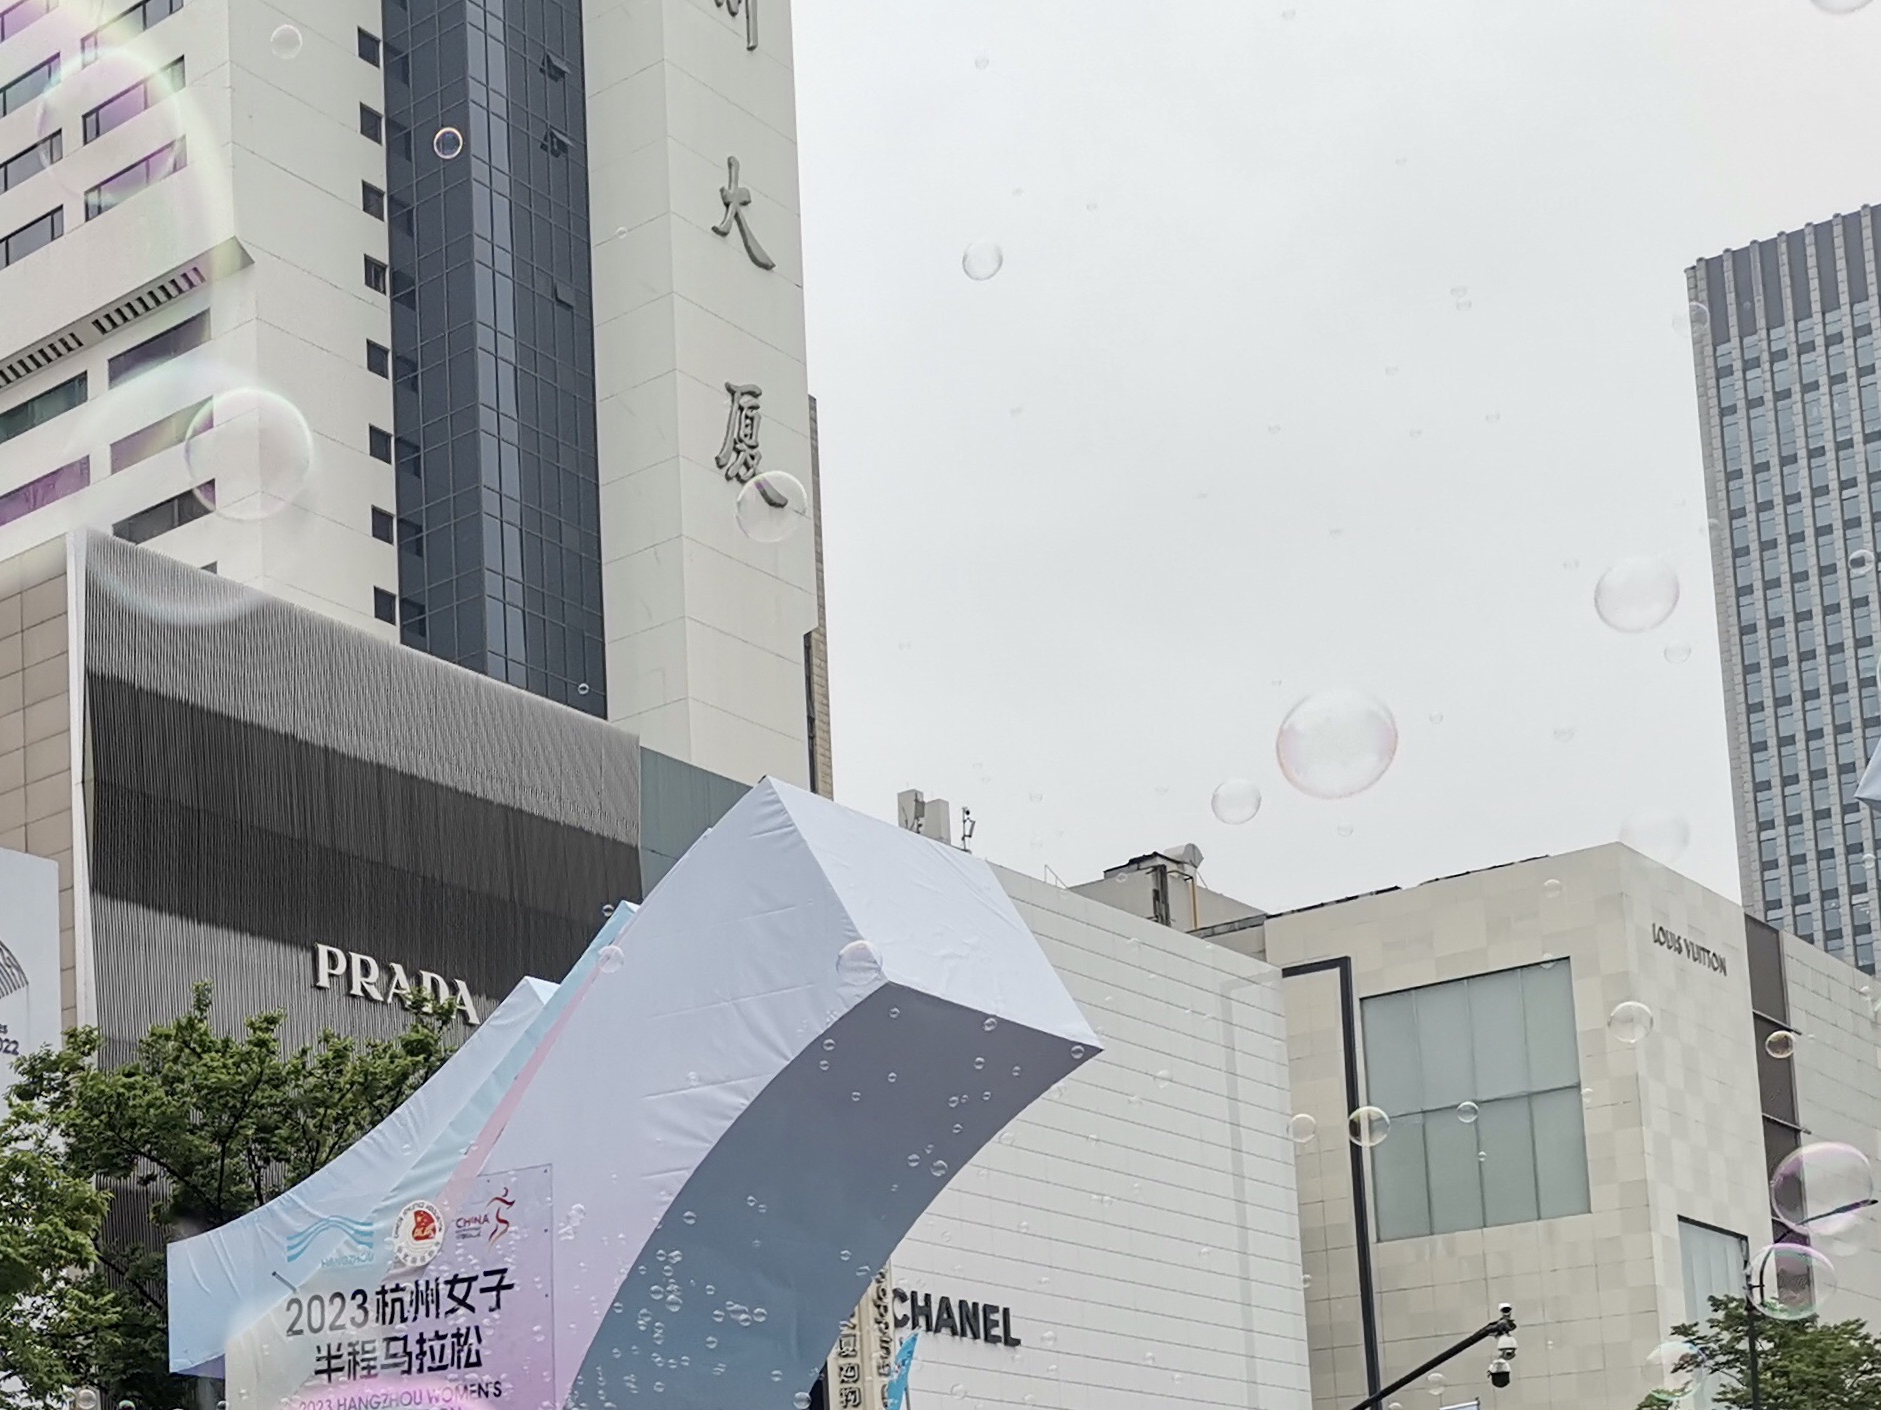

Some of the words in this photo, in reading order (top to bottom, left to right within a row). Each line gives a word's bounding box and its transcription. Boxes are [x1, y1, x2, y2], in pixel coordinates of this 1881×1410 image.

[1651, 923, 1682, 954] LOUIS
[1683, 938, 1728, 977] VUITTON
[313, 941, 481, 1025] PRADA
[455, 1213, 490, 1229] CHINA
[891, 1286, 1022, 1348] CHANEL
[314, 1325, 484, 1384] 半程马拉松
